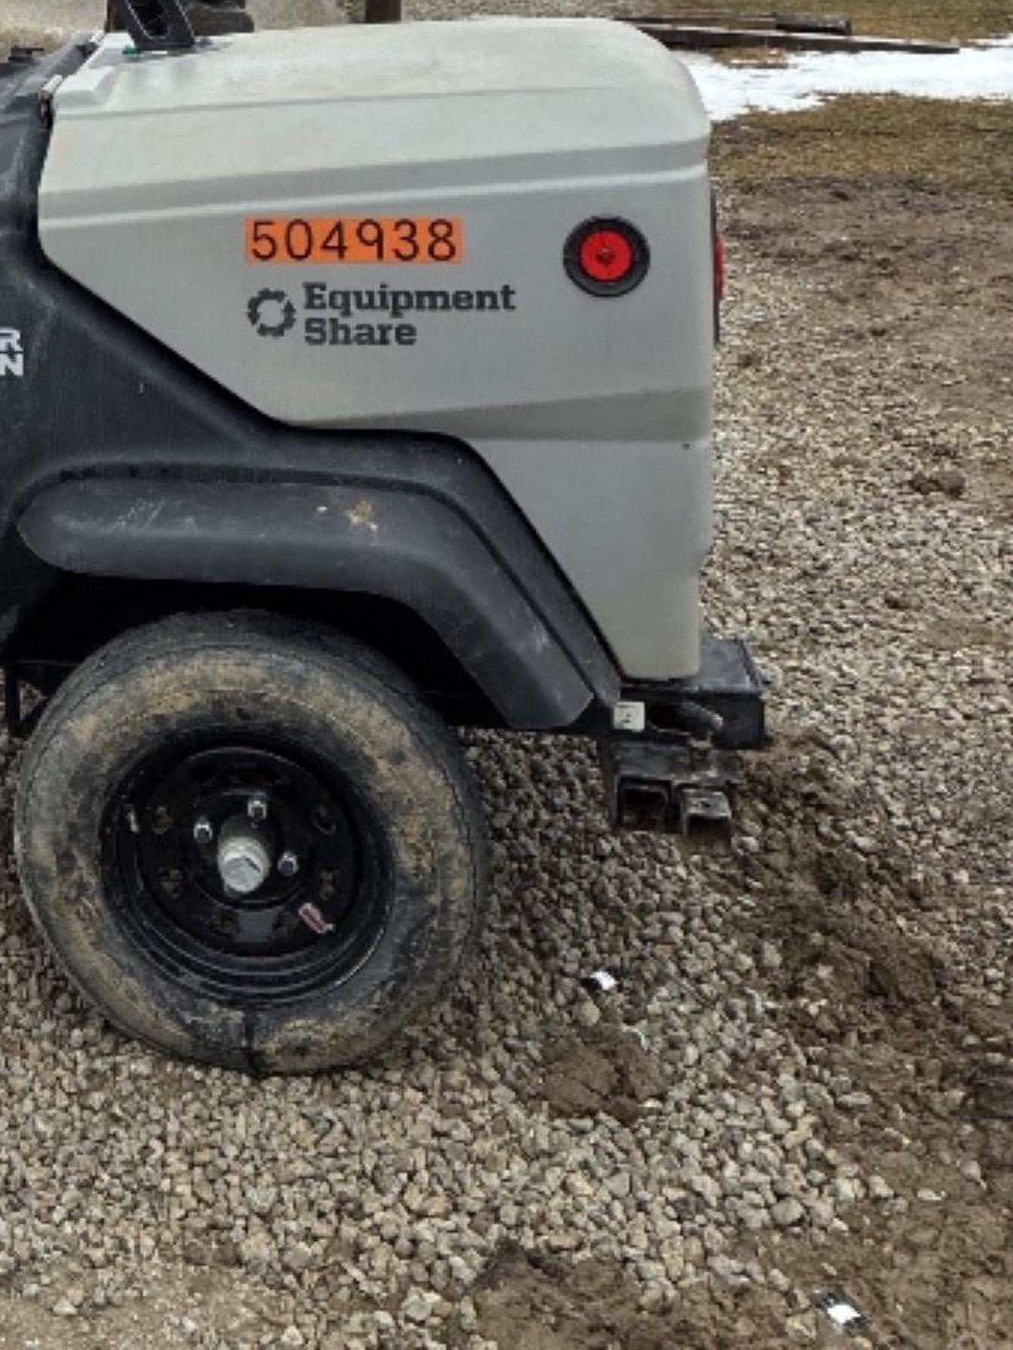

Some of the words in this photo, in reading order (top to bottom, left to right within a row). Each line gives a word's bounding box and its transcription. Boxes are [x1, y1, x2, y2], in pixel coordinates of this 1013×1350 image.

[251, 218, 457, 262] 504938
[302, 282, 517, 318] Equipment
[304, 317, 418, 347] Share
